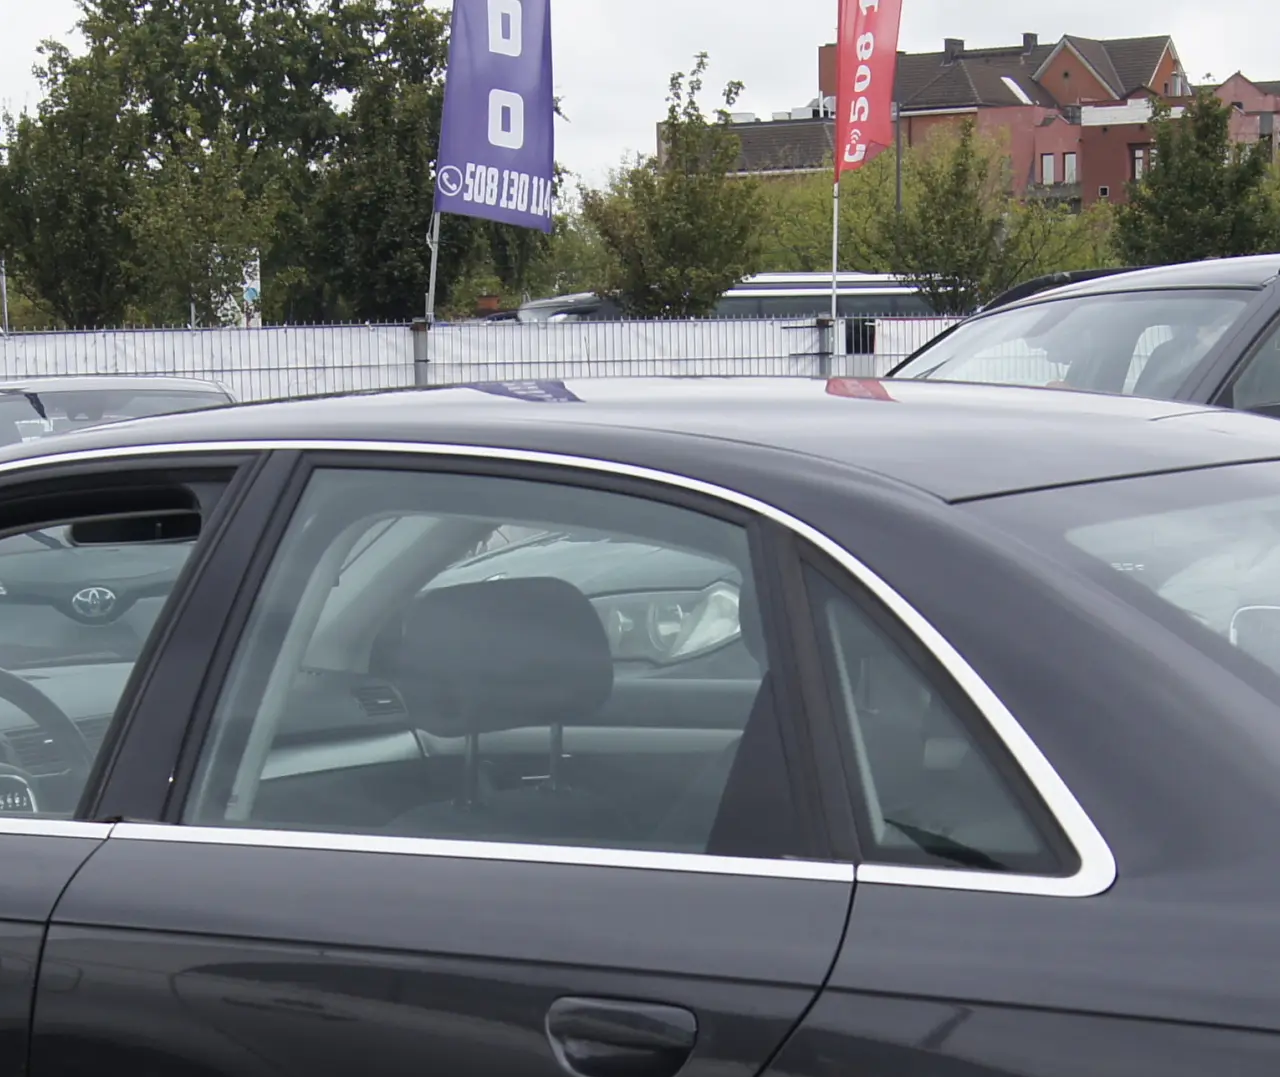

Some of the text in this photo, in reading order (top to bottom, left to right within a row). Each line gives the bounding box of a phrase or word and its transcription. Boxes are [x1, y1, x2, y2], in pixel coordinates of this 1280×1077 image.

[849, 31, 874, 124] 508
[463, 162, 552, 218] 508 130 114
